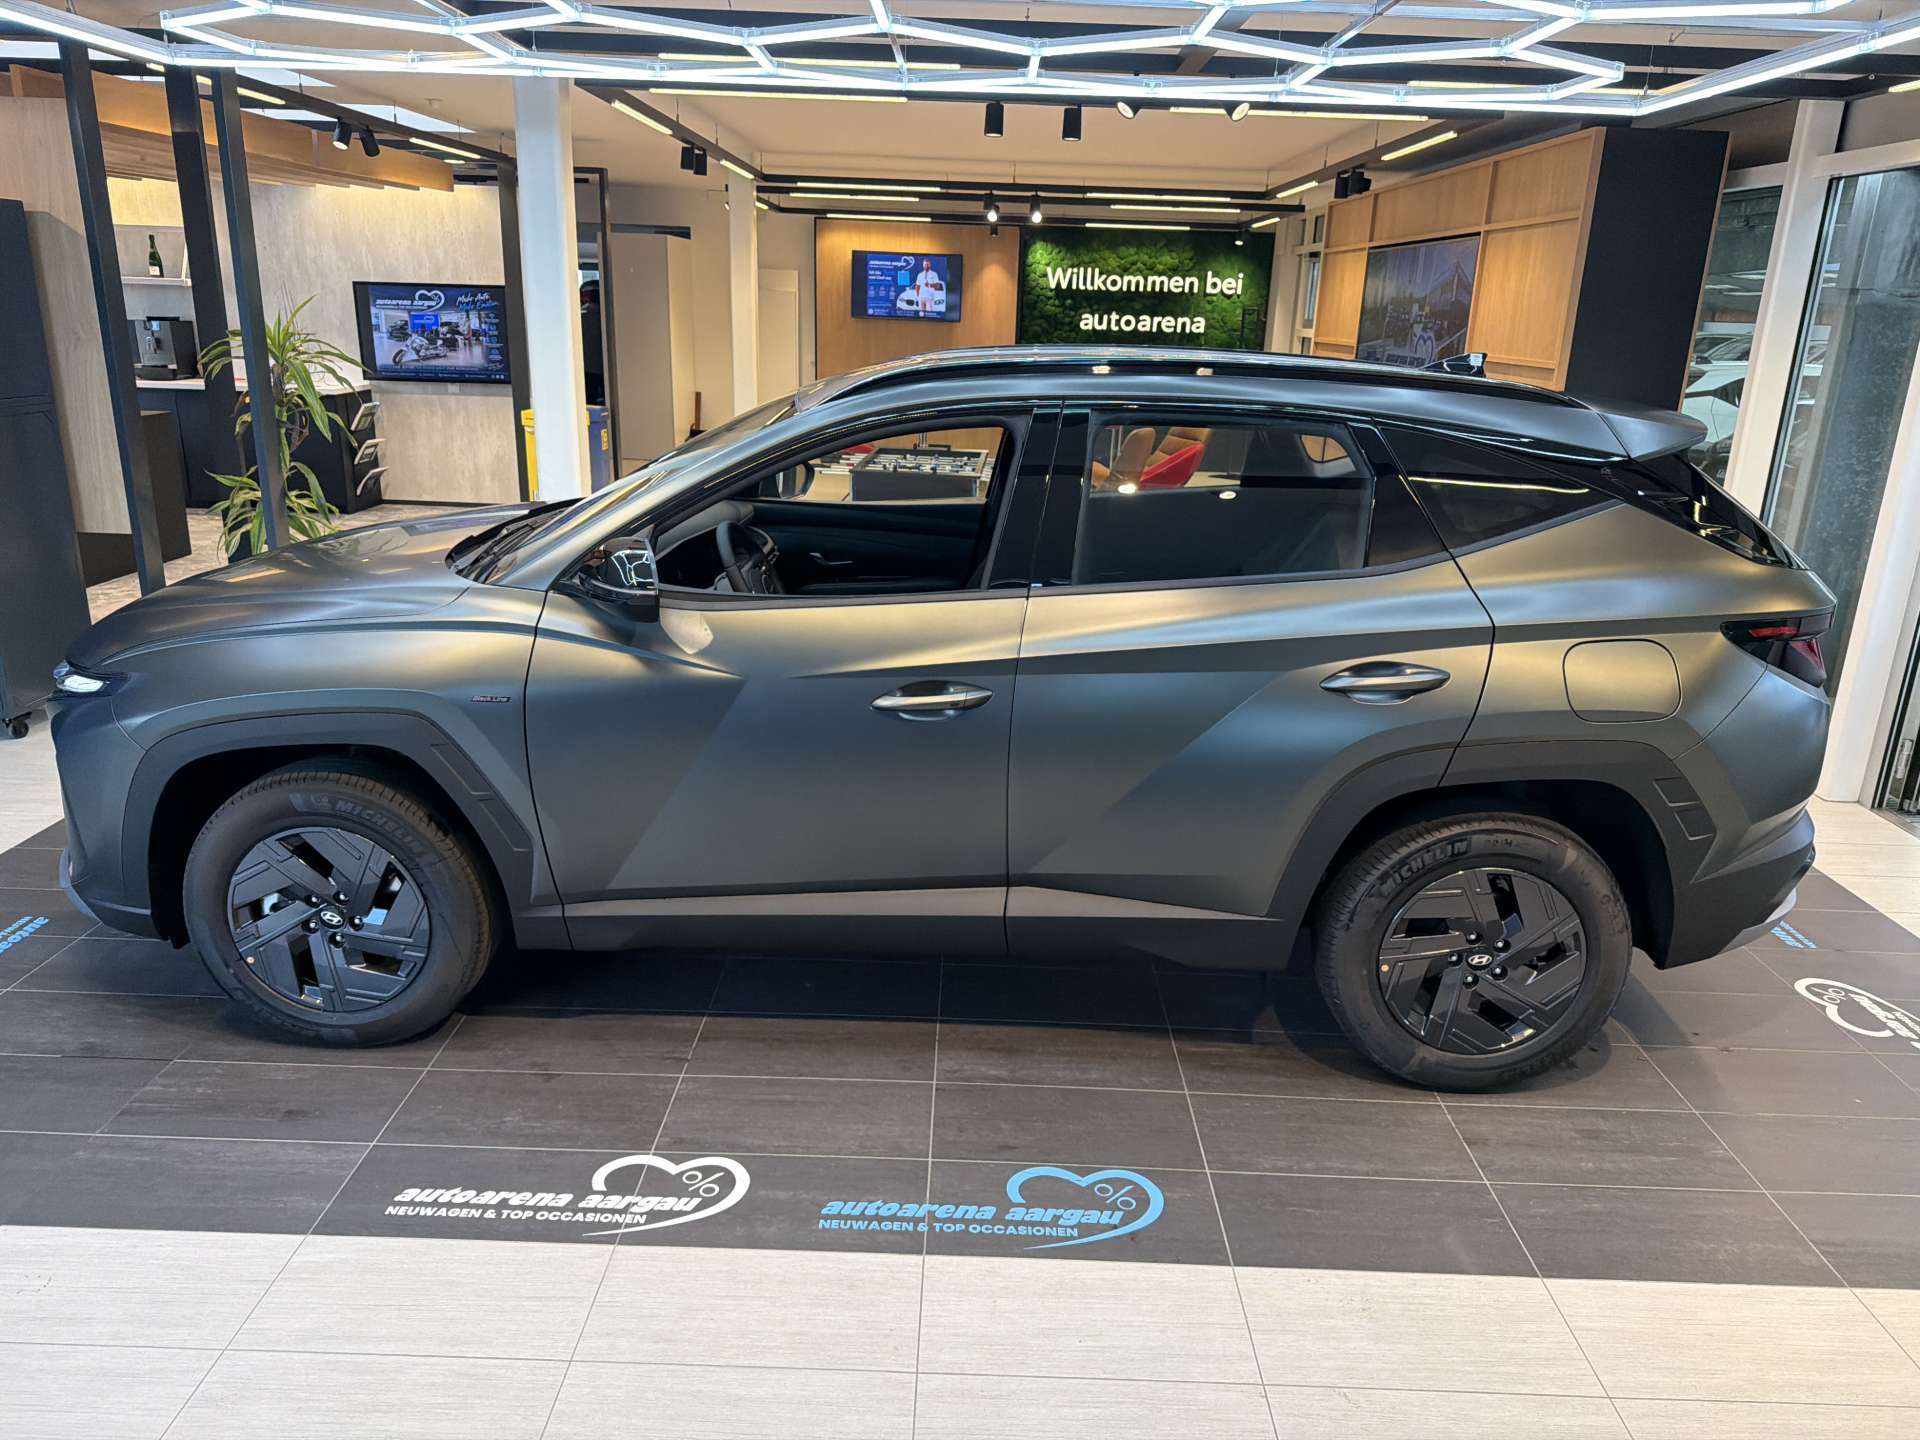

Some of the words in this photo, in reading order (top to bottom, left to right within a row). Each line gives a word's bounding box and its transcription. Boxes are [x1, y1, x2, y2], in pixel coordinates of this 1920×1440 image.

[1046, 267, 1199, 294] Willkommen
[1205, 271, 1244, 295] bei
[1079, 311, 1206, 334] autoarena
[1379, 838, 1471, 895] MICHELIN
[394, 1187, 575, 1207] autoarena
[581, 1194, 704, 1213] aargau
[820, 1200, 997, 1220] autoarena
[1004, 1204, 1124, 1225] aargau
[385, 1205, 482, 1218] NEUWAGEN
[484, 1210, 498, 1219] &
[501, 1209, 533, 1220] TOP
[536, 1211, 648, 1224] OCCASIONEN
[818, 1219, 916, 1232] NEUWAGEN
[917, 1222, 929, 1232] &
[934, 1223, 965, 1232] TOP
[968, 1223, 1079, 1237] OCCASIONEN
